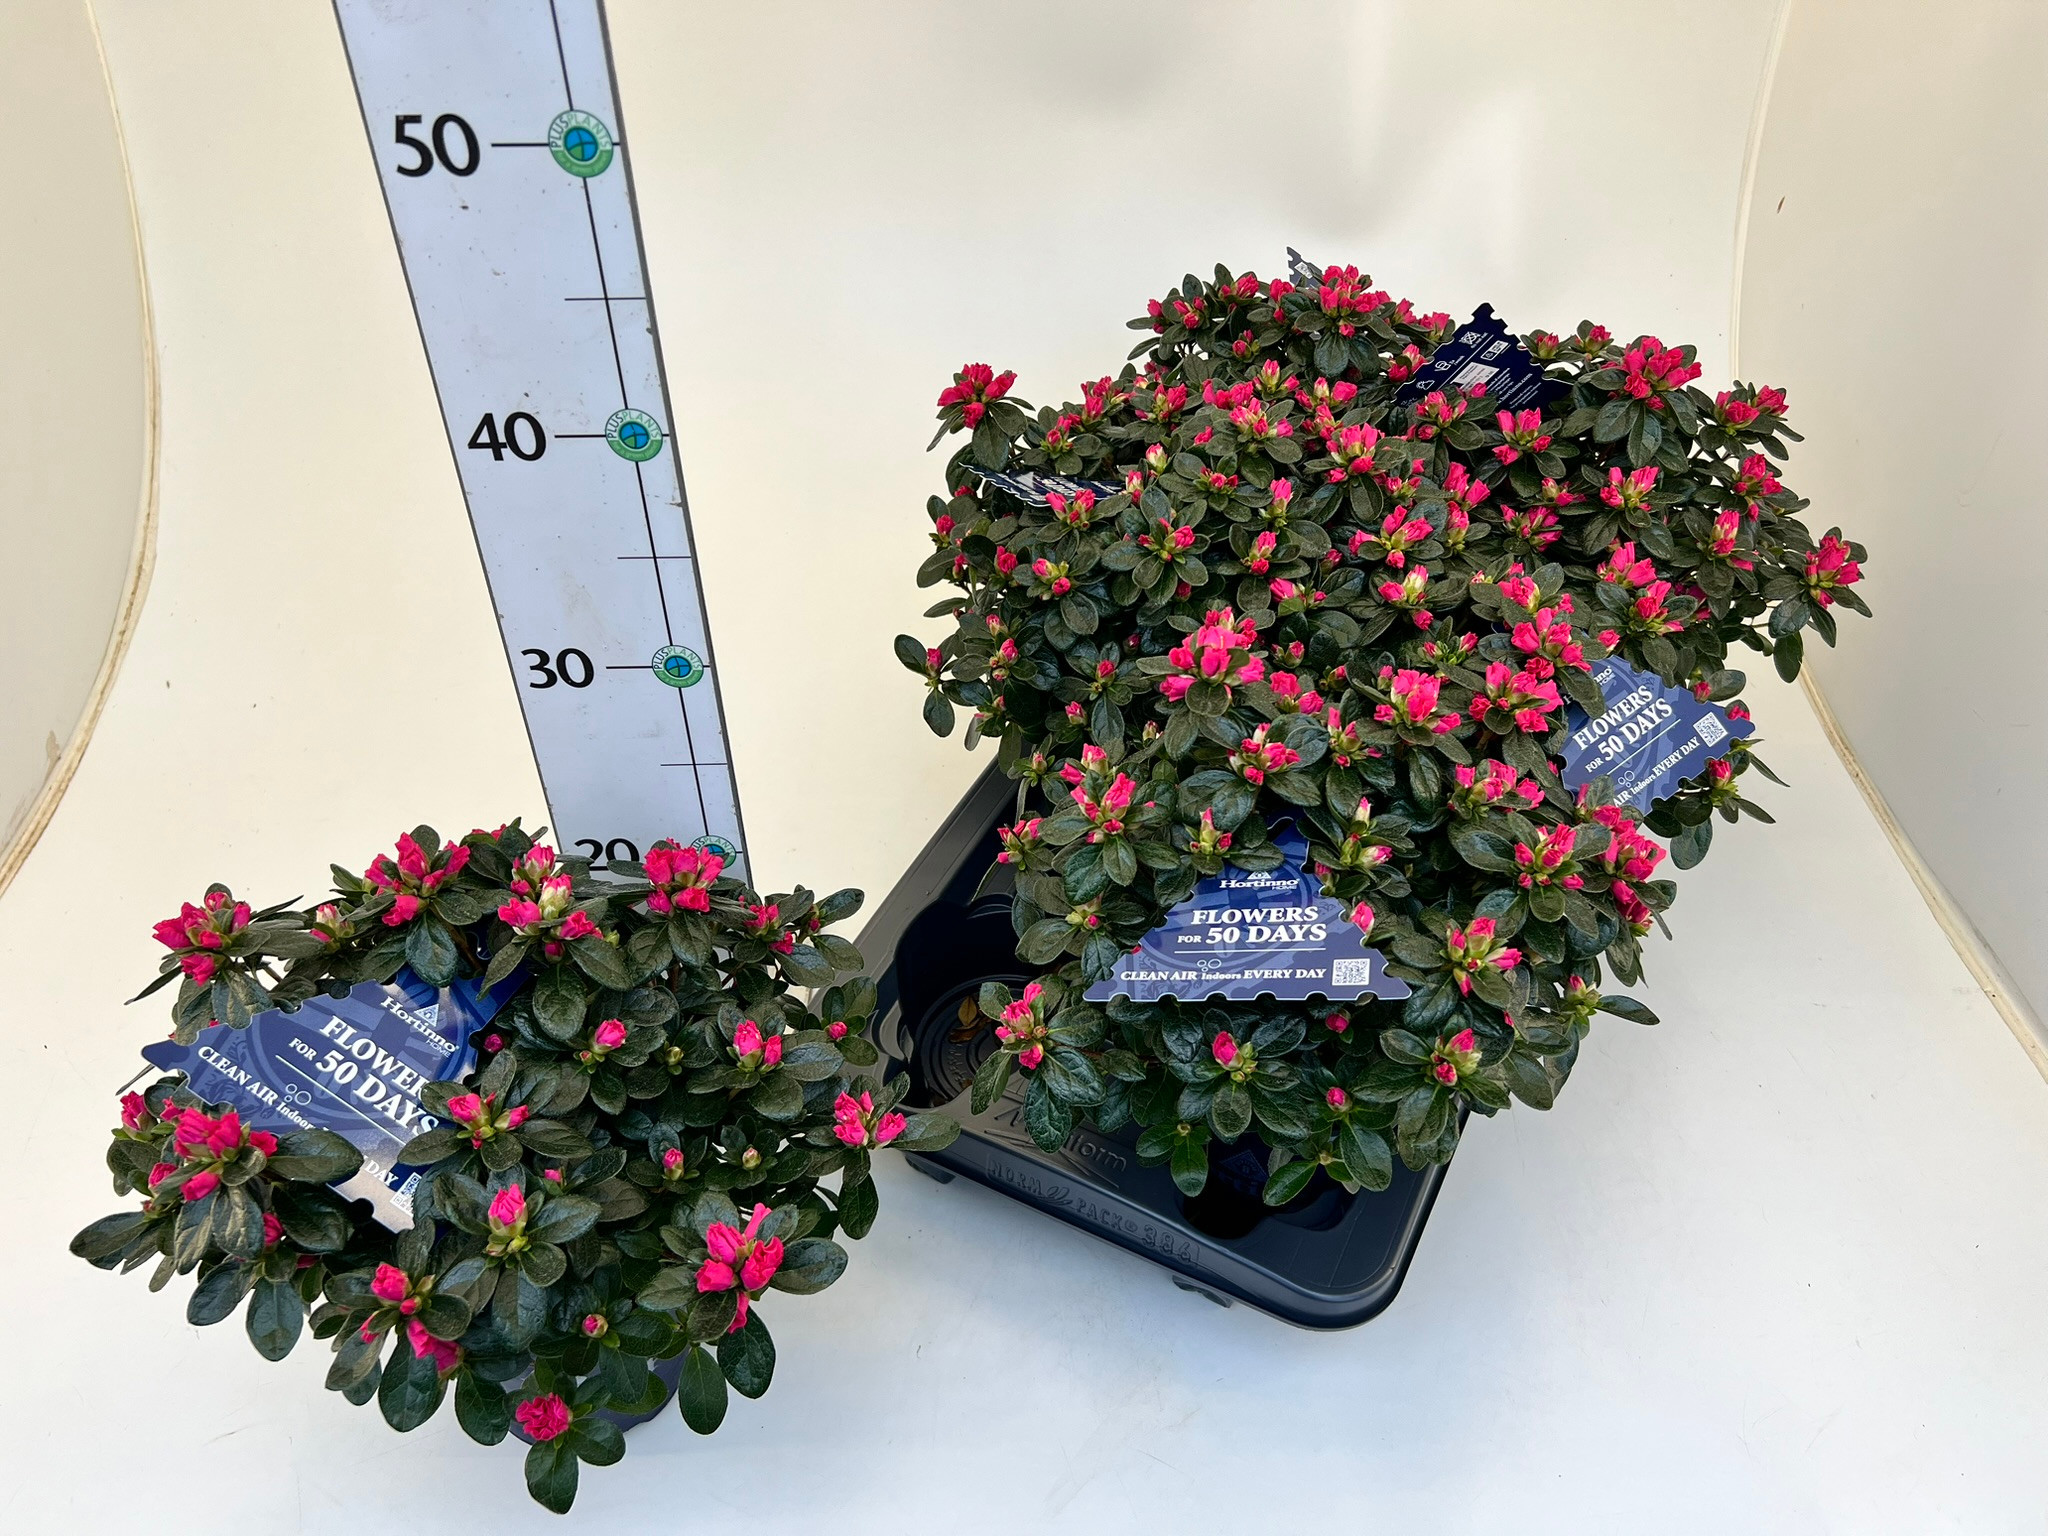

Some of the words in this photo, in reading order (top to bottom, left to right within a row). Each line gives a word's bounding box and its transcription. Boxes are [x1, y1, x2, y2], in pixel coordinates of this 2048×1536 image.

[395, 113, 481, 177] 50
[467, 411, 547, 462] 40
[520, 647, 595, 689] 30
[1572, 685, 1653, 751] FLOWERS
[1584, 757, 1604, 773] FOR
[1597, 734, 1624, 761] 50
[1619, 697, 1673, 745] DAYS
[1613, 790, 1632, 808] AIR
[1630, 773, 1656, 794] Indoors
[1652, 749, 1683, 777] EVERY
[1680, 736, 1701, 756] DAY
[574, 838, 640, 871] 20
[1219, 878, 1299, 889] Hortinno
[1177, 935, 1202, 943] FOR
[1205, 926, 1240, 944] 50
[1246, 923, 1328, 944] DAYS
[1190, 906, 1319, 925] FLOWERS
[1120, 971, 1170, 981] CLEAN
[1169, 971, 1198, 981] AIR
[1201, 971, 1242, 980] Indoors
[1243, 969, 1293, 979] EVERY
[1294, 968, 1327, 979] DAY
[380, 996, 456, 1053] Hortinno
[425, 1038, 451, 1058] HOME
[289, 1037, 318, 1061] FOR
[315, 1049, 359, 1085] 50
[198, 1046, 252, 1086] CLEAN
[246, 1081, 279, 1106] AIR
[276, 1101, 317, 1131] Indoor
[365, 1159, 399, 1187] DAY
